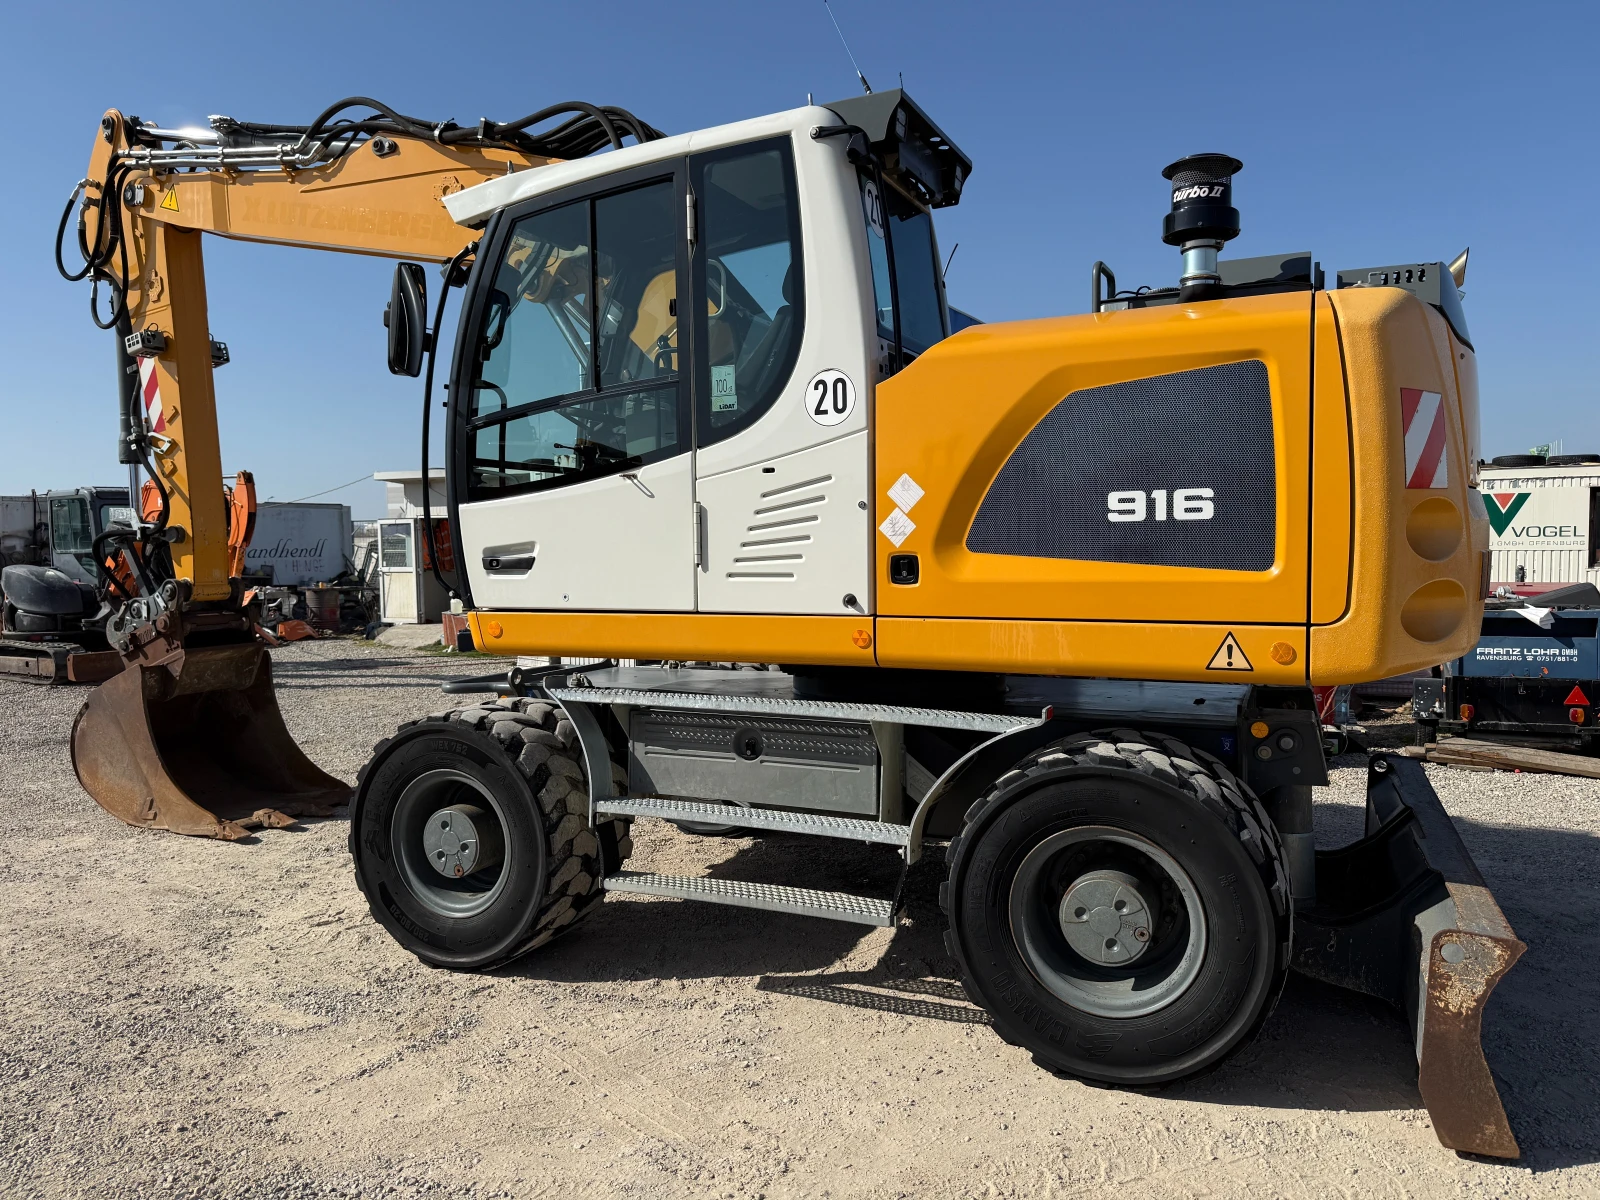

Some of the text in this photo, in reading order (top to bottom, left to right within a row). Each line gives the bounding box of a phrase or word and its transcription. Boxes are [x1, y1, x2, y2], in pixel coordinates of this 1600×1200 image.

[1173, 185, 1209, 203] turbo
[715, 378, 728, 393] 100
[813, 377, 848, 416] 20
[1107, 487, 1215, 522] 916
[1511, 525, 1585, 538] VOGEL
[247, 538, 328, 559] andhendl
[1476, 647, 1578, 656] FRANZ LOHR GMBH
[430, 740, 468, 755] WEX 752
